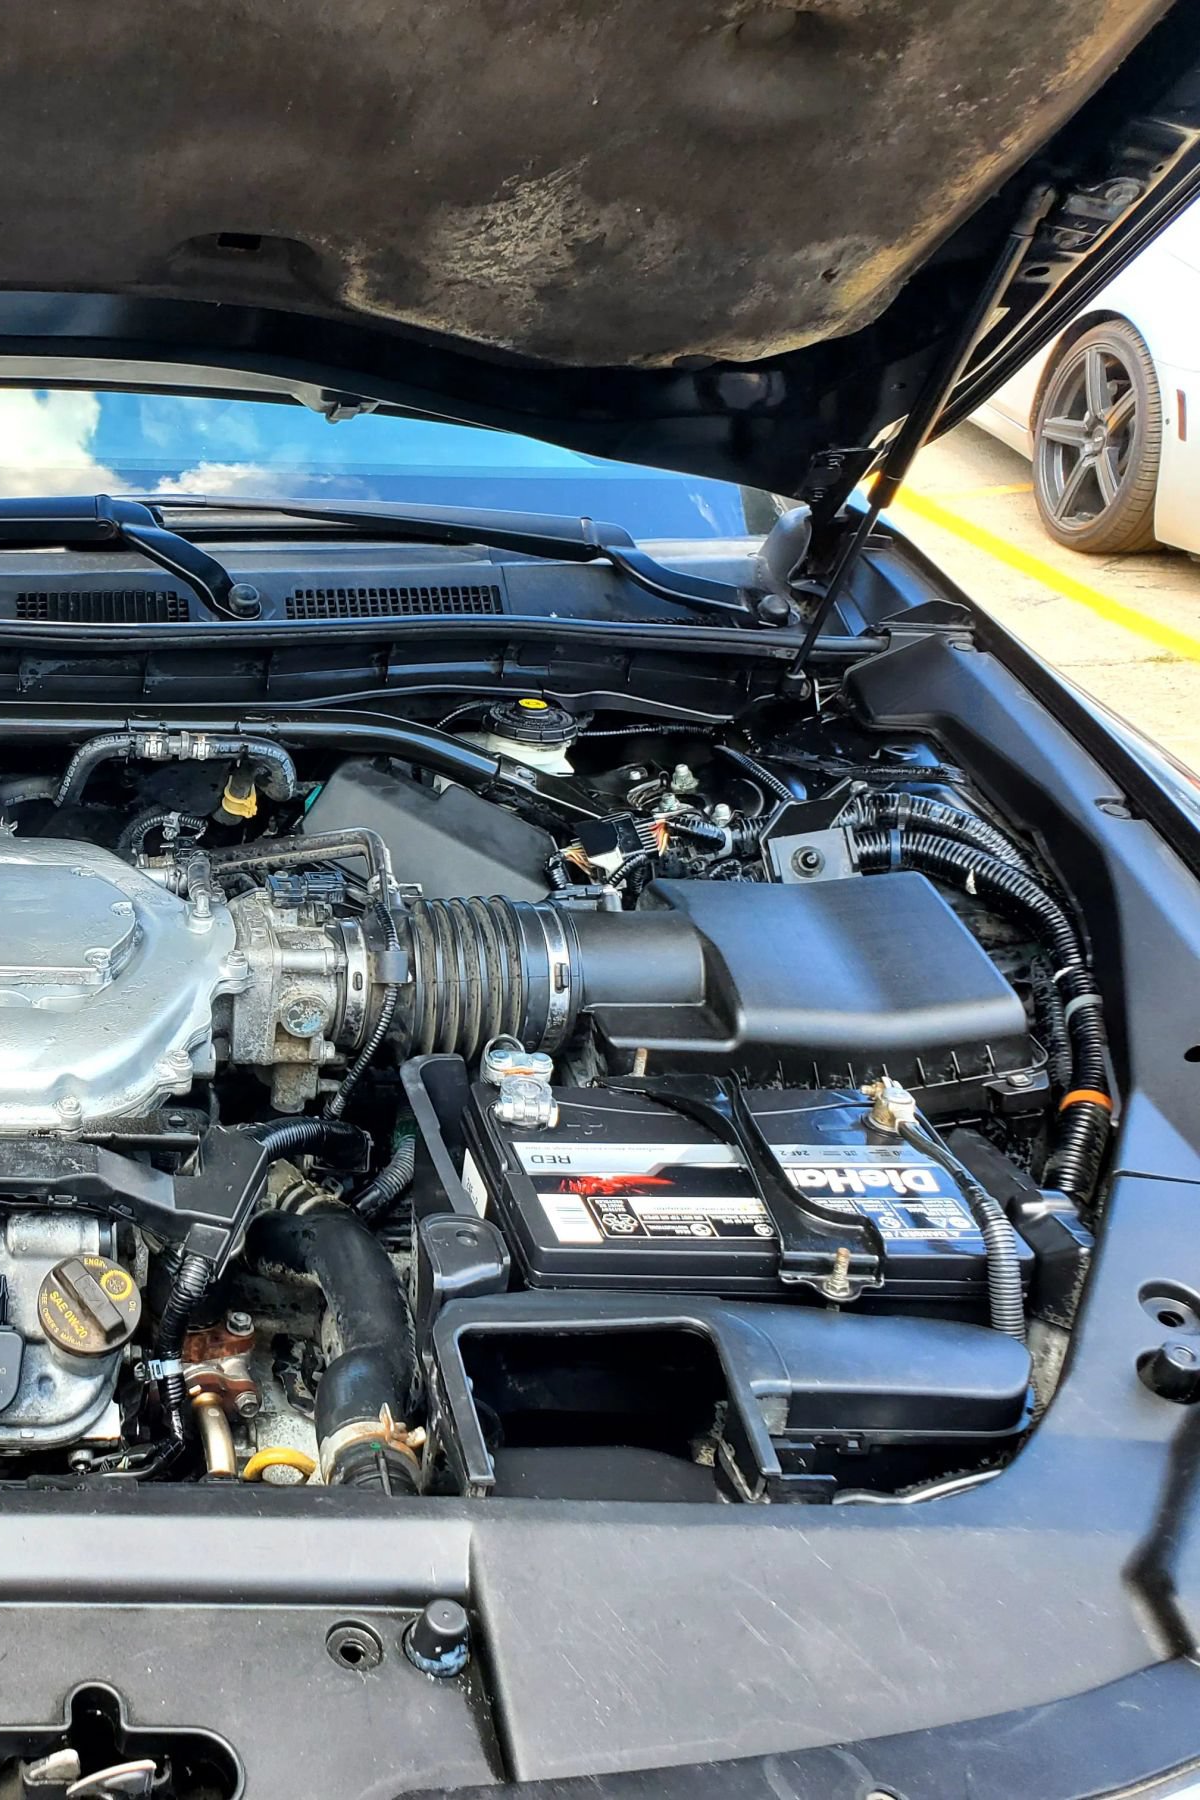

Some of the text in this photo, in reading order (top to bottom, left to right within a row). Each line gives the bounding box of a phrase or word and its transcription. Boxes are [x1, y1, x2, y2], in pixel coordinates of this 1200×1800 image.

[530, 1154, 572, 1165] RED
[783, 1168, 941, 1194] DieHa
[49, 1290, 88, 1339] SAE 0W-20
